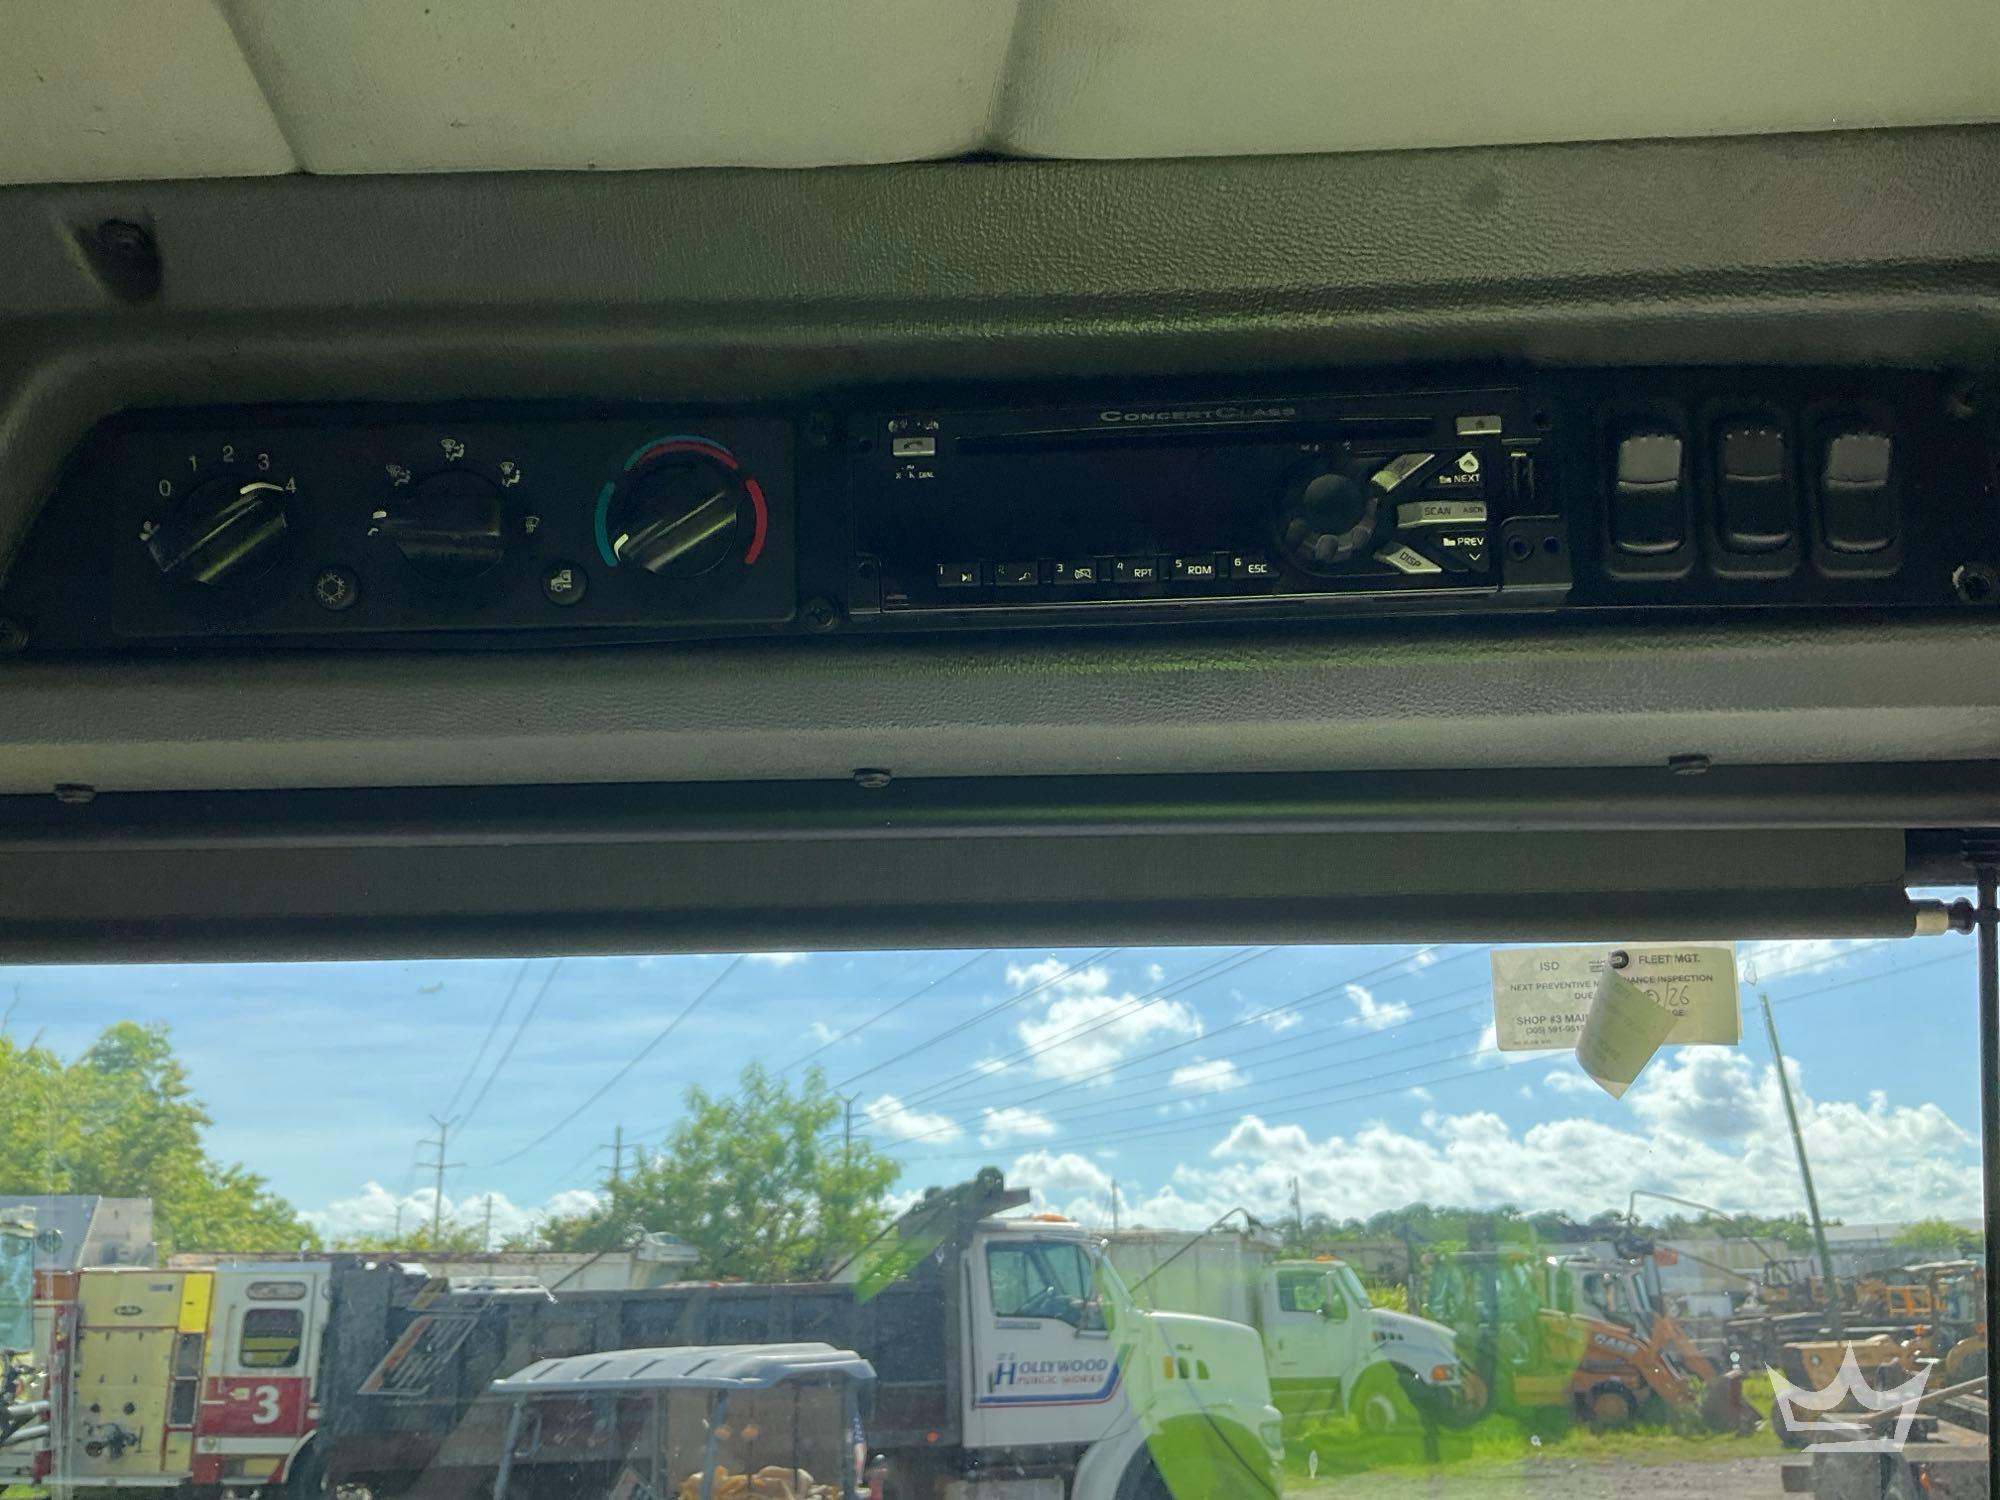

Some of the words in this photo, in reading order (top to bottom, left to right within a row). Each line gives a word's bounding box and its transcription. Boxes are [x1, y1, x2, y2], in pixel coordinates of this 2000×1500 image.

[223, 445, 234, 463] 2
[189, 454, 198, 472] 1
[257, 453, 271, 471] 3
[286, 477, 297, 493] 4
[1454, 474, 1481, 483] NEXT
[158, 479, 172, 497] 0
[1424, 506, 1452, 516] SCAN
[1457, 537, 1485, 547] PREV
[1175, 559, 1183, 568] 5
[1234, 557, 1242, 567] 6
[1248, 564, 1268, 574] ESC
[1400, 551, 1422, 568] DISP
[1056, 563, 1064, 573] 3
[1116, 562, 1124, 571] 4
[1133, 567, 1153, 578] RPT
[1638, 955, 1670, 965] FLEET
[1674, 953, 1701, 963] MGT.
[1539, 961, 1560, 972] ISD
[1657, 974, 1714, 983] INSPECTION
[1510, 983, 1533, 992] NEXT
[1536, 981, 1591, 990] PREVENTIVE
[1517, 1016, 1546, 1025] SHOP
[996, 1359, 1108, 1385] HOLLYWOOD
[252, 1384, 280, 1425] 3
